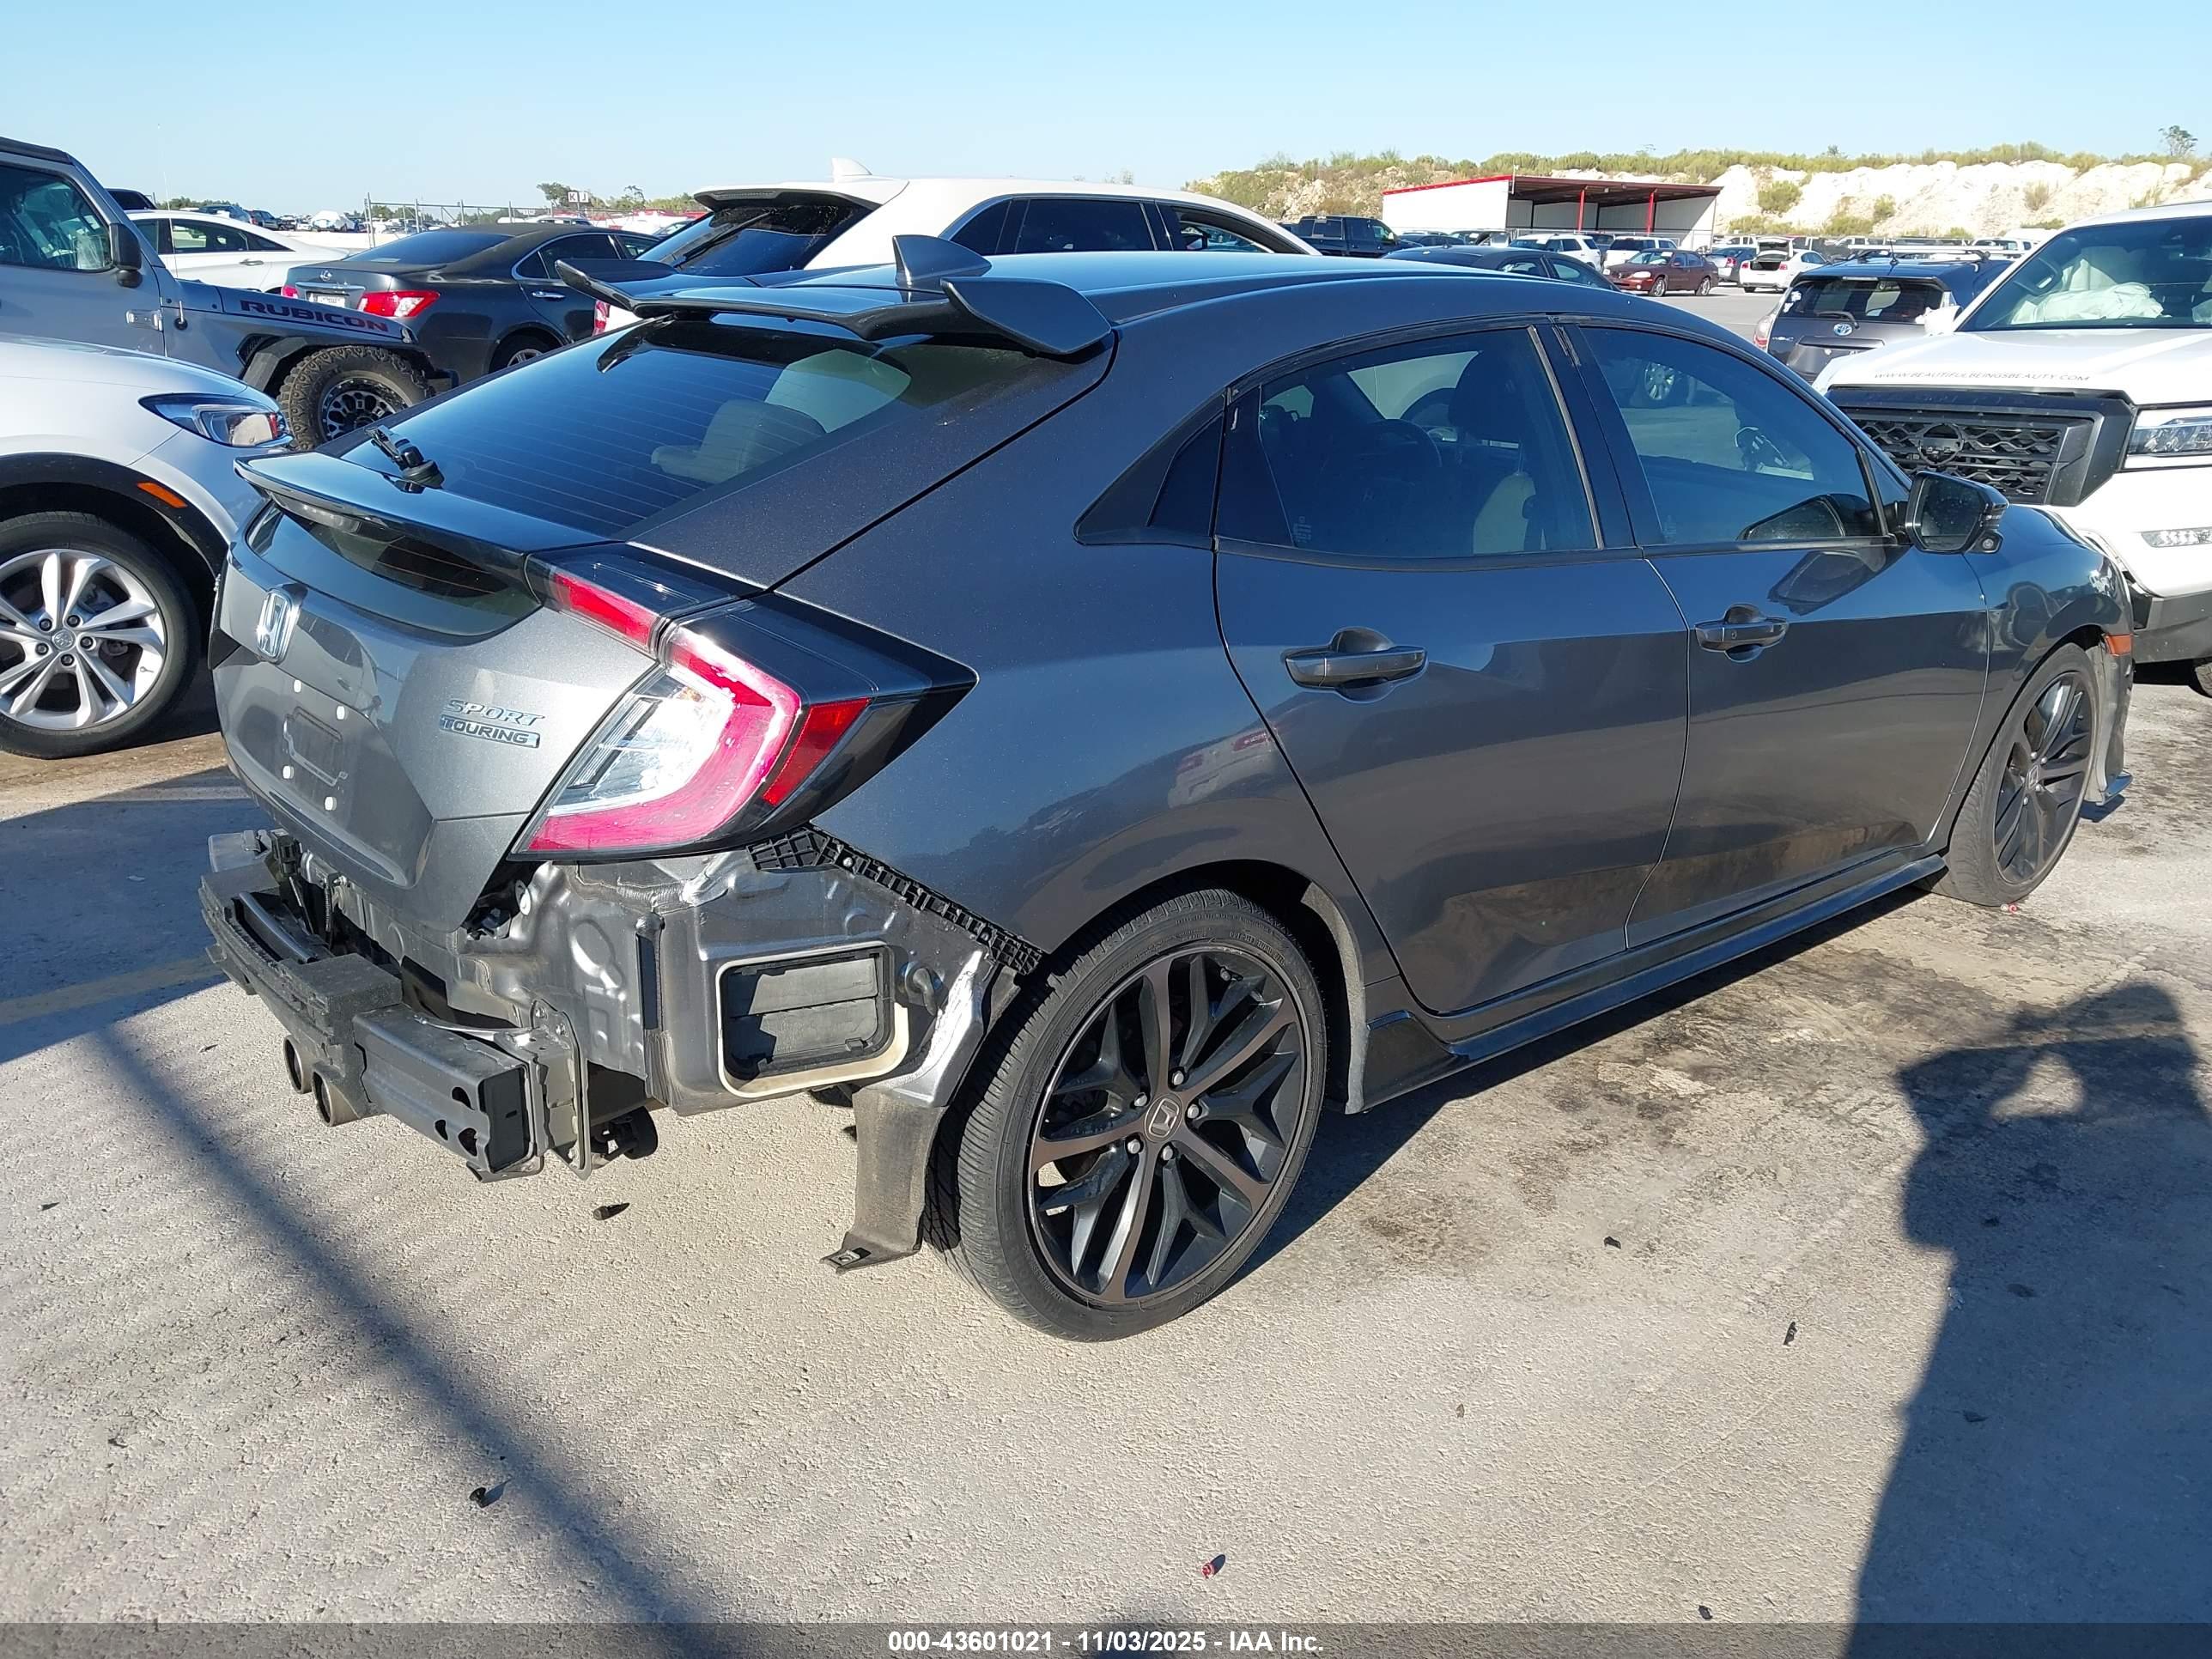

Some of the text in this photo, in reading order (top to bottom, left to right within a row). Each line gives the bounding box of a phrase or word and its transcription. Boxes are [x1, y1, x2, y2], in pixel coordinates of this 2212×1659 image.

[240, 300, 389, 332] RUBICON
[444, 698, 545, 726] SPORT
[441, 716, 530, 744] TOURING
